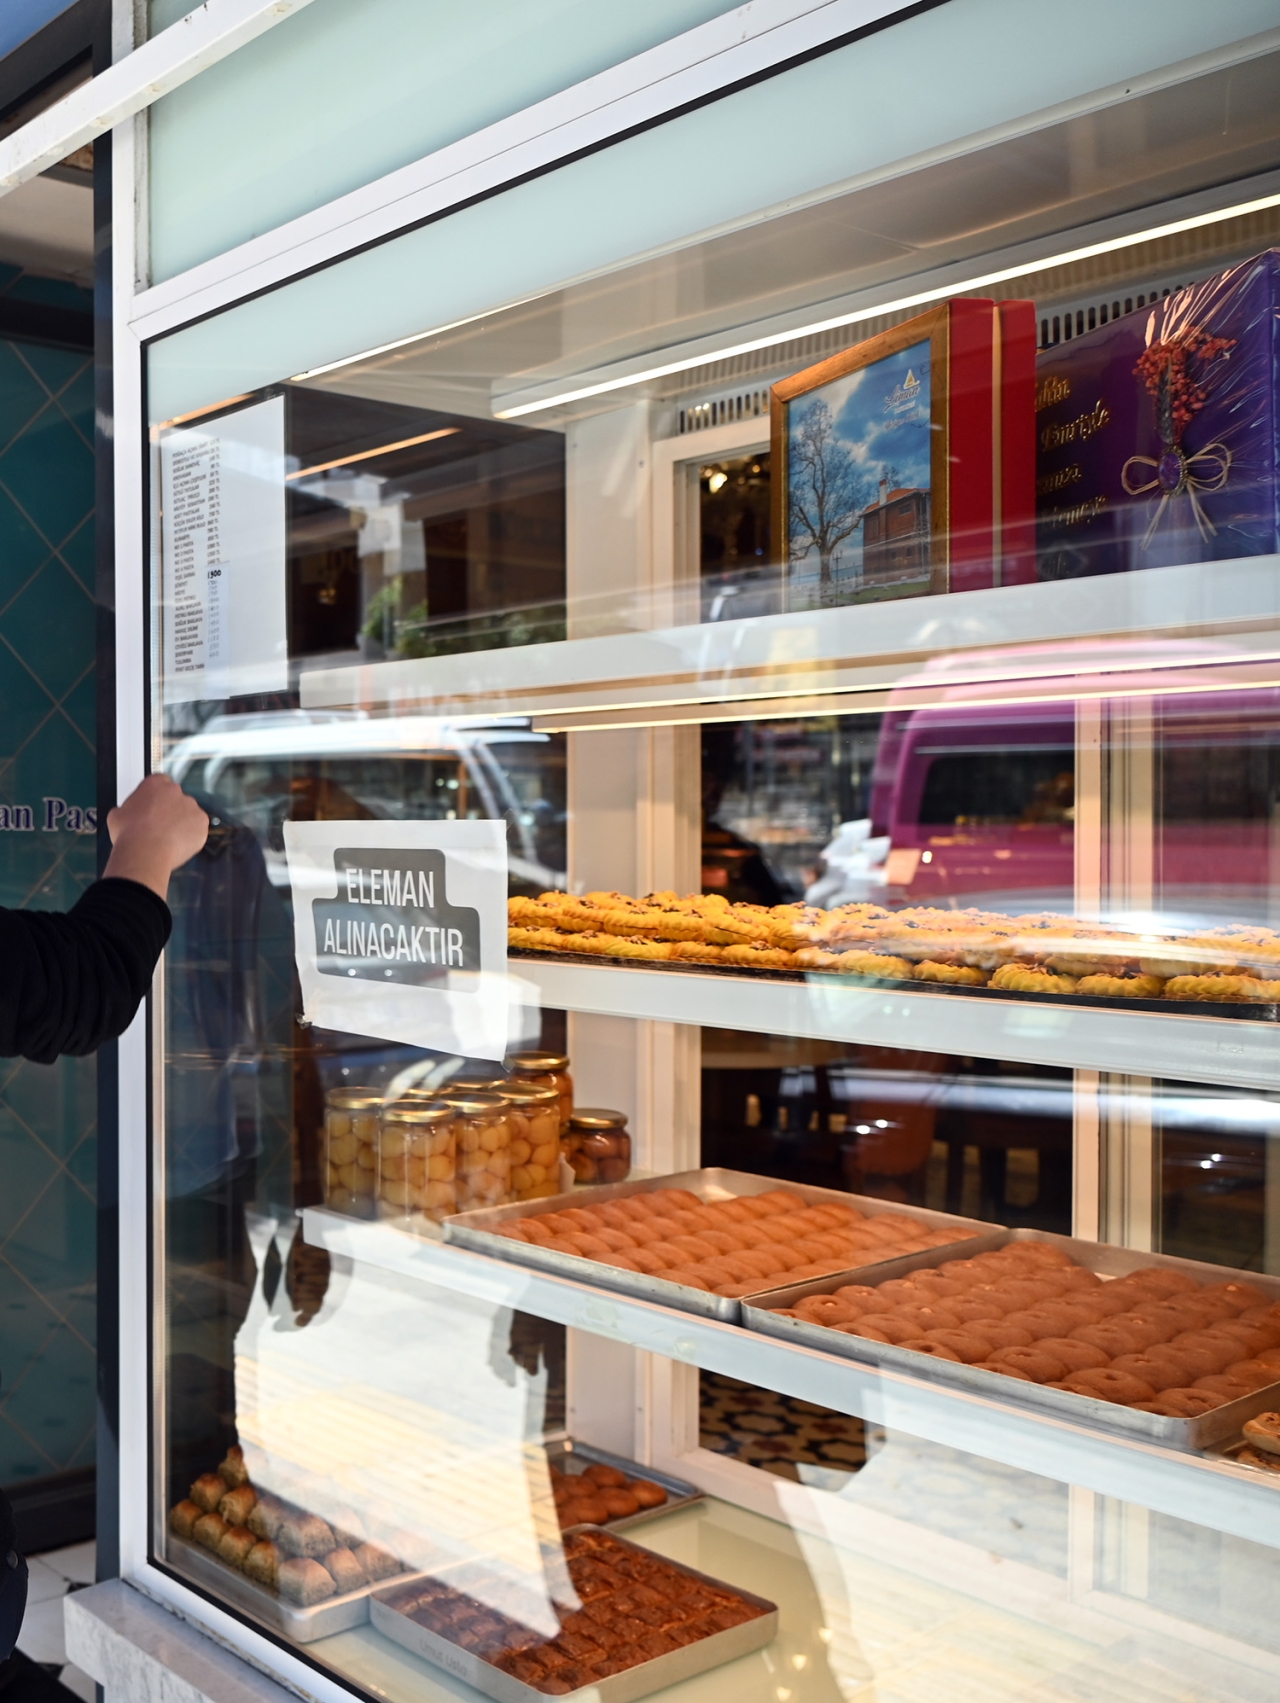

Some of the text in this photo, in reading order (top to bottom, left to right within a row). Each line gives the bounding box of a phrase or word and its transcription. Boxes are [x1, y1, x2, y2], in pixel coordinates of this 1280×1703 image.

[42, 797, 98, 835] Pas
[345, 867, 435, 909] ELEMAN
[323, 918, 464, 967] ALINACAKTIR
